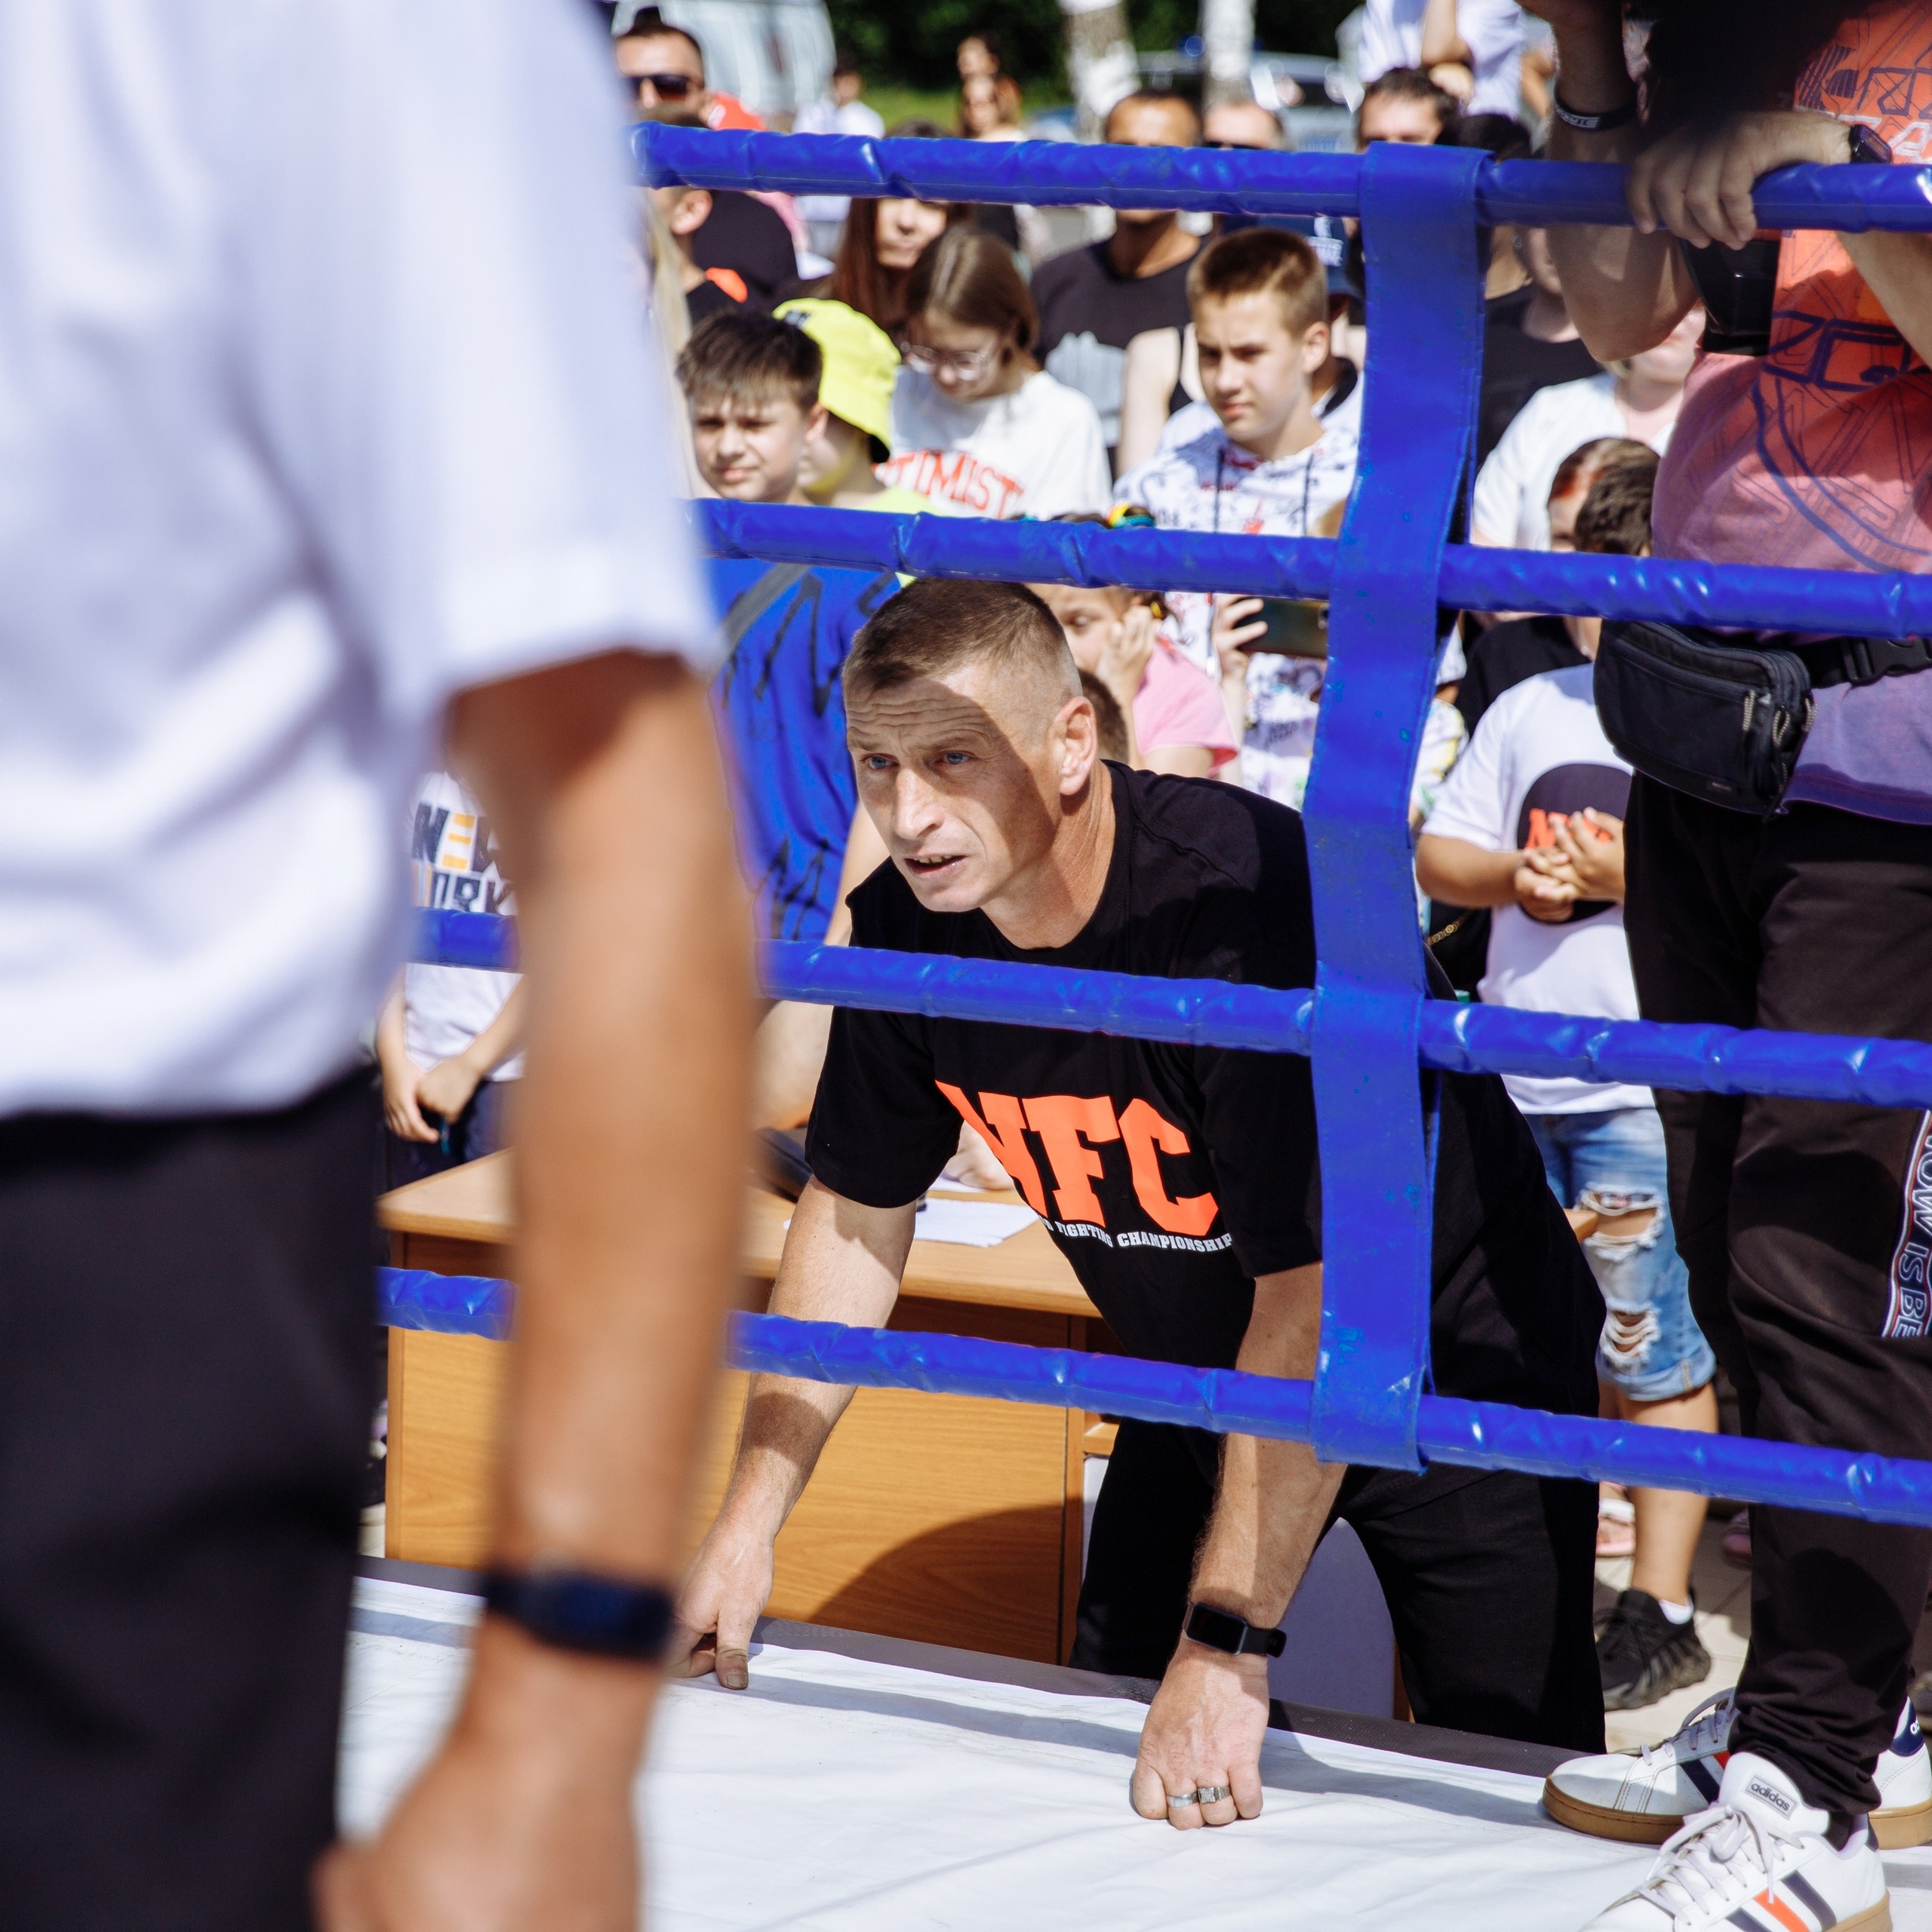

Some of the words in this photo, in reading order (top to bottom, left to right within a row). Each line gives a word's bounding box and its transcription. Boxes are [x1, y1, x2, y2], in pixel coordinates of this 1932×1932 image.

[872, 451, 1026, 521] TIMIST
[1055, 1221, 1113, 1247] FIGHTING
[1117, 1231, 1232, 1252] CHAMPIONSHIP
[1898, 1241, 1930, 1283] IS
[1751, 1783, 1790, 1810] adidas
